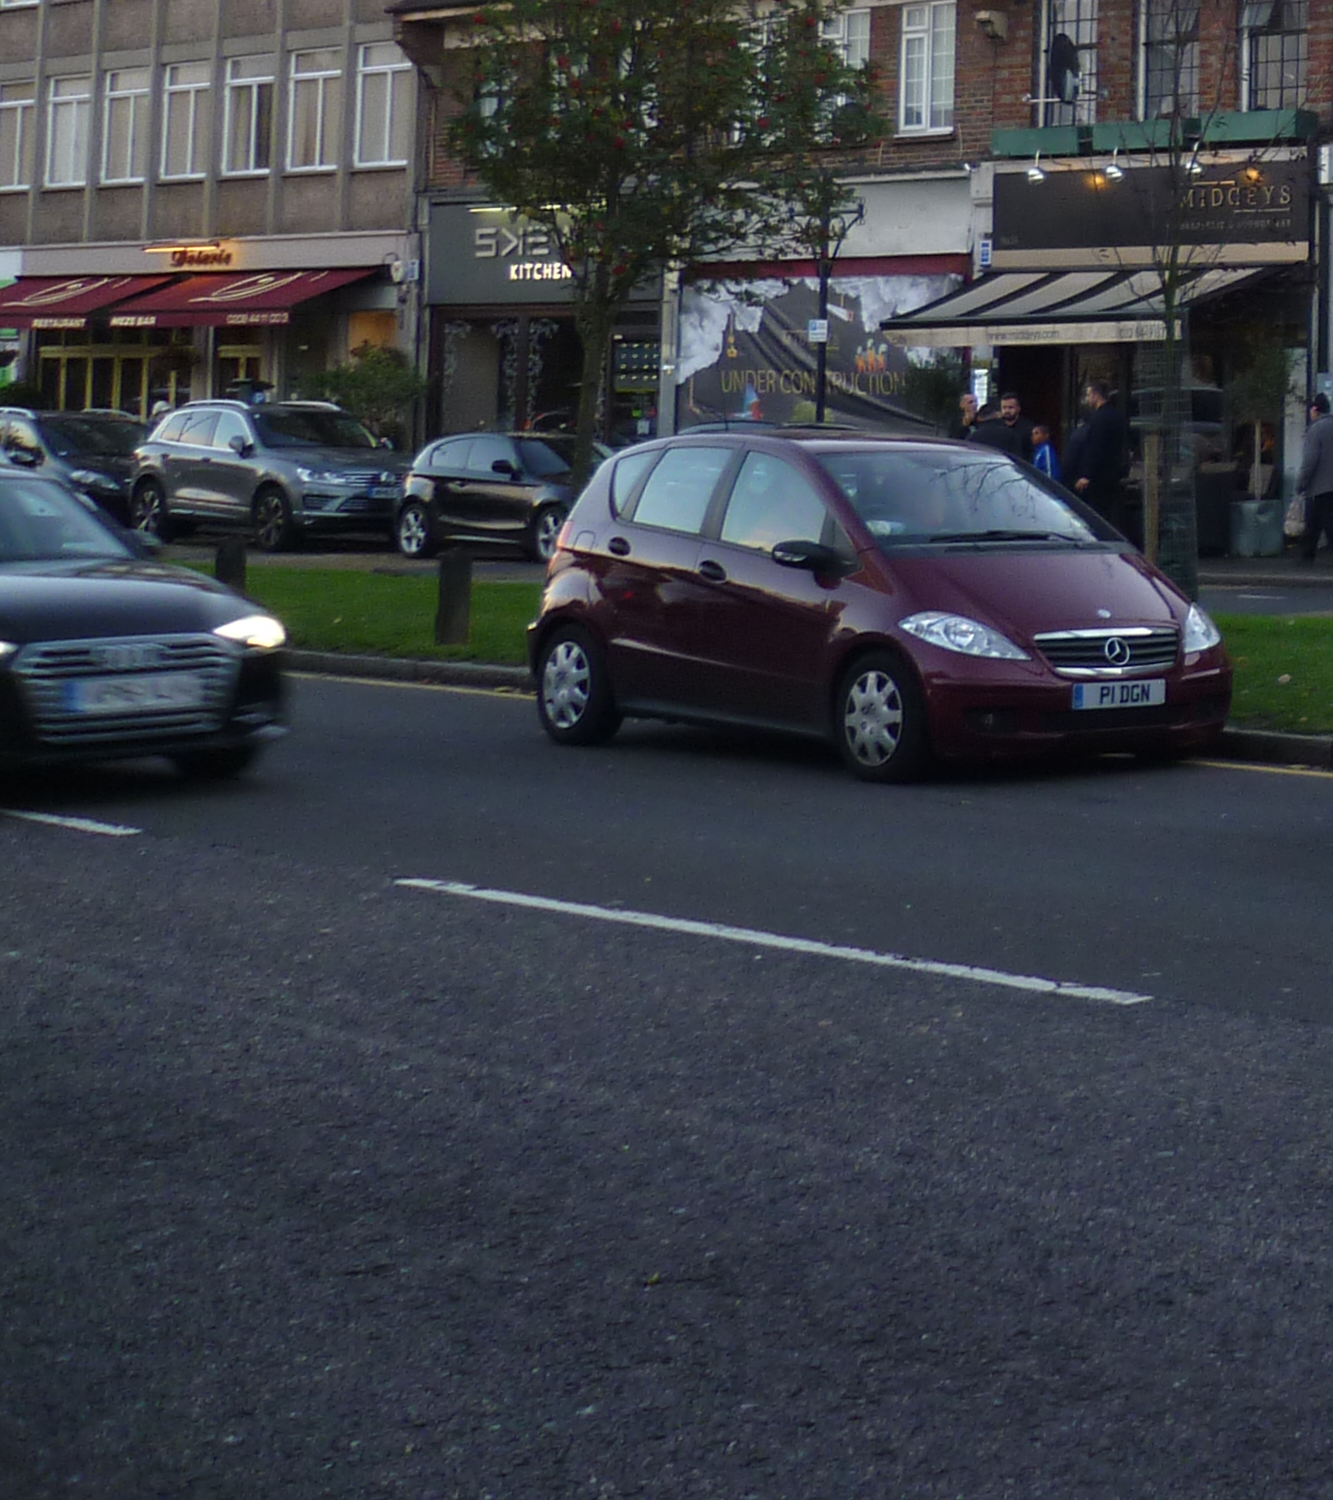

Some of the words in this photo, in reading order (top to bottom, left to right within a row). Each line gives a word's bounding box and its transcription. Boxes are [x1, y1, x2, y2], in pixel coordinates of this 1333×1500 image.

[509, 261, 572, 280] KITCHEN
[721, 369, 776, 393] UNDER
[780, 369, 905, 395] CONTRUCTION
[1120, 683, 1151, 704] DGN
